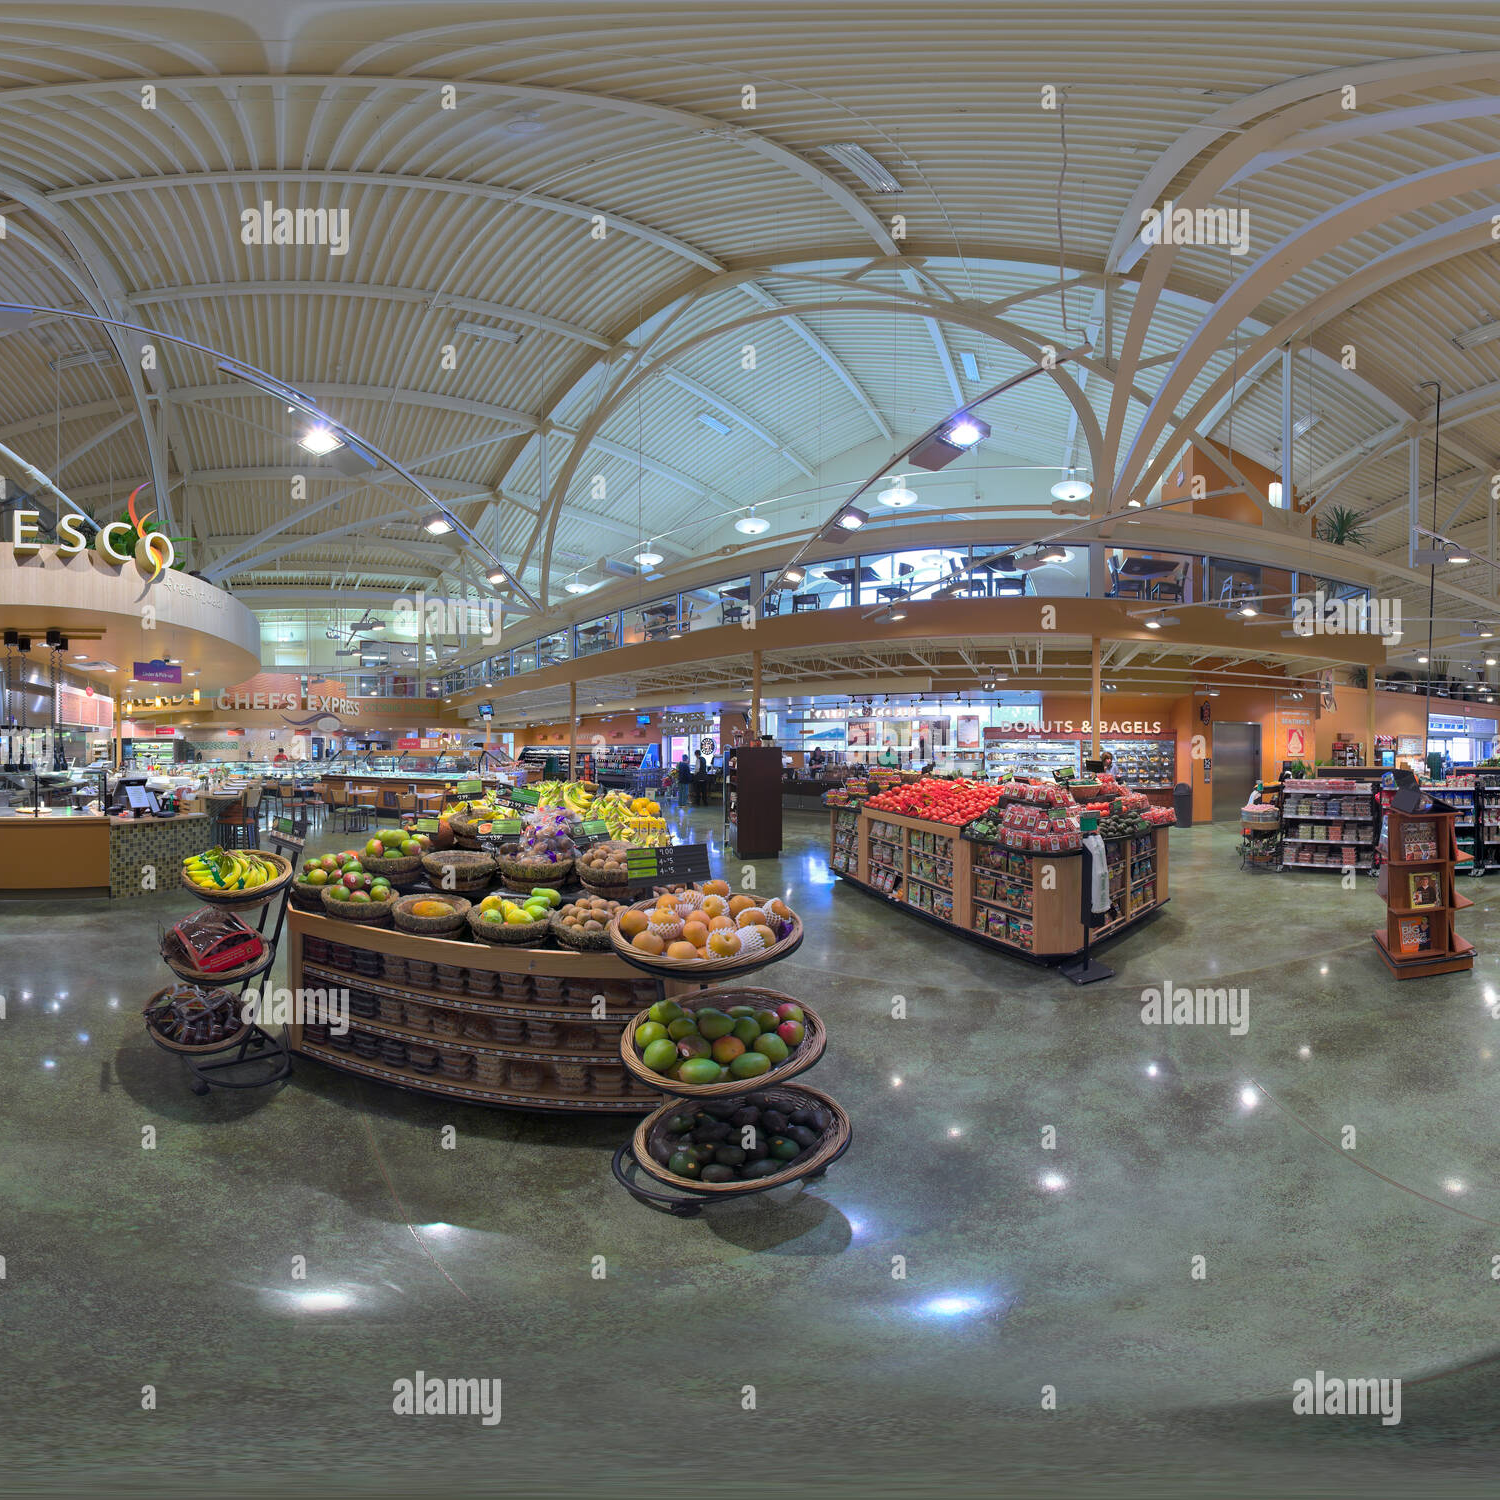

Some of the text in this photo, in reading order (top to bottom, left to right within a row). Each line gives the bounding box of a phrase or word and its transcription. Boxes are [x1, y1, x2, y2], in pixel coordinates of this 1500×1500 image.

[217, 692, 297, 711] CHEF'S
[307, 694, 360, 716] EXPRESS
[1001, 720, 1073, 734] DONUTS
[1100, 720, 1161, 734] BAGELS
